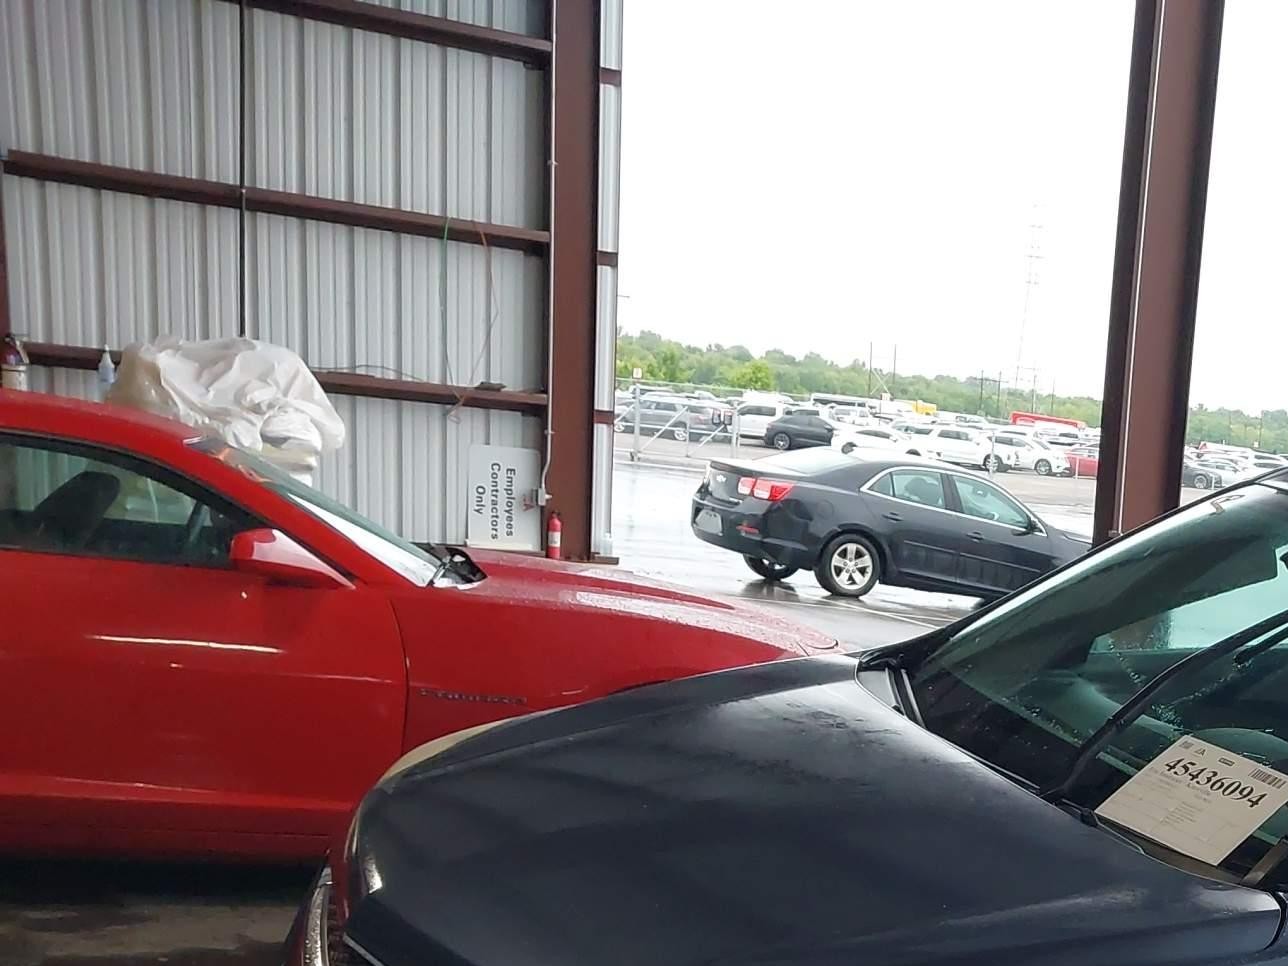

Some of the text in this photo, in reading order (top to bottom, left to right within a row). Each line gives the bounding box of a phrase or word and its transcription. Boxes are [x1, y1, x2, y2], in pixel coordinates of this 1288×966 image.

[473, 485, 486, 515] Only
[491, 462, 501, 540] Contractors
[503, 468, 516, 537] Employees
[1164, 757, 1268, 808] 45436094
